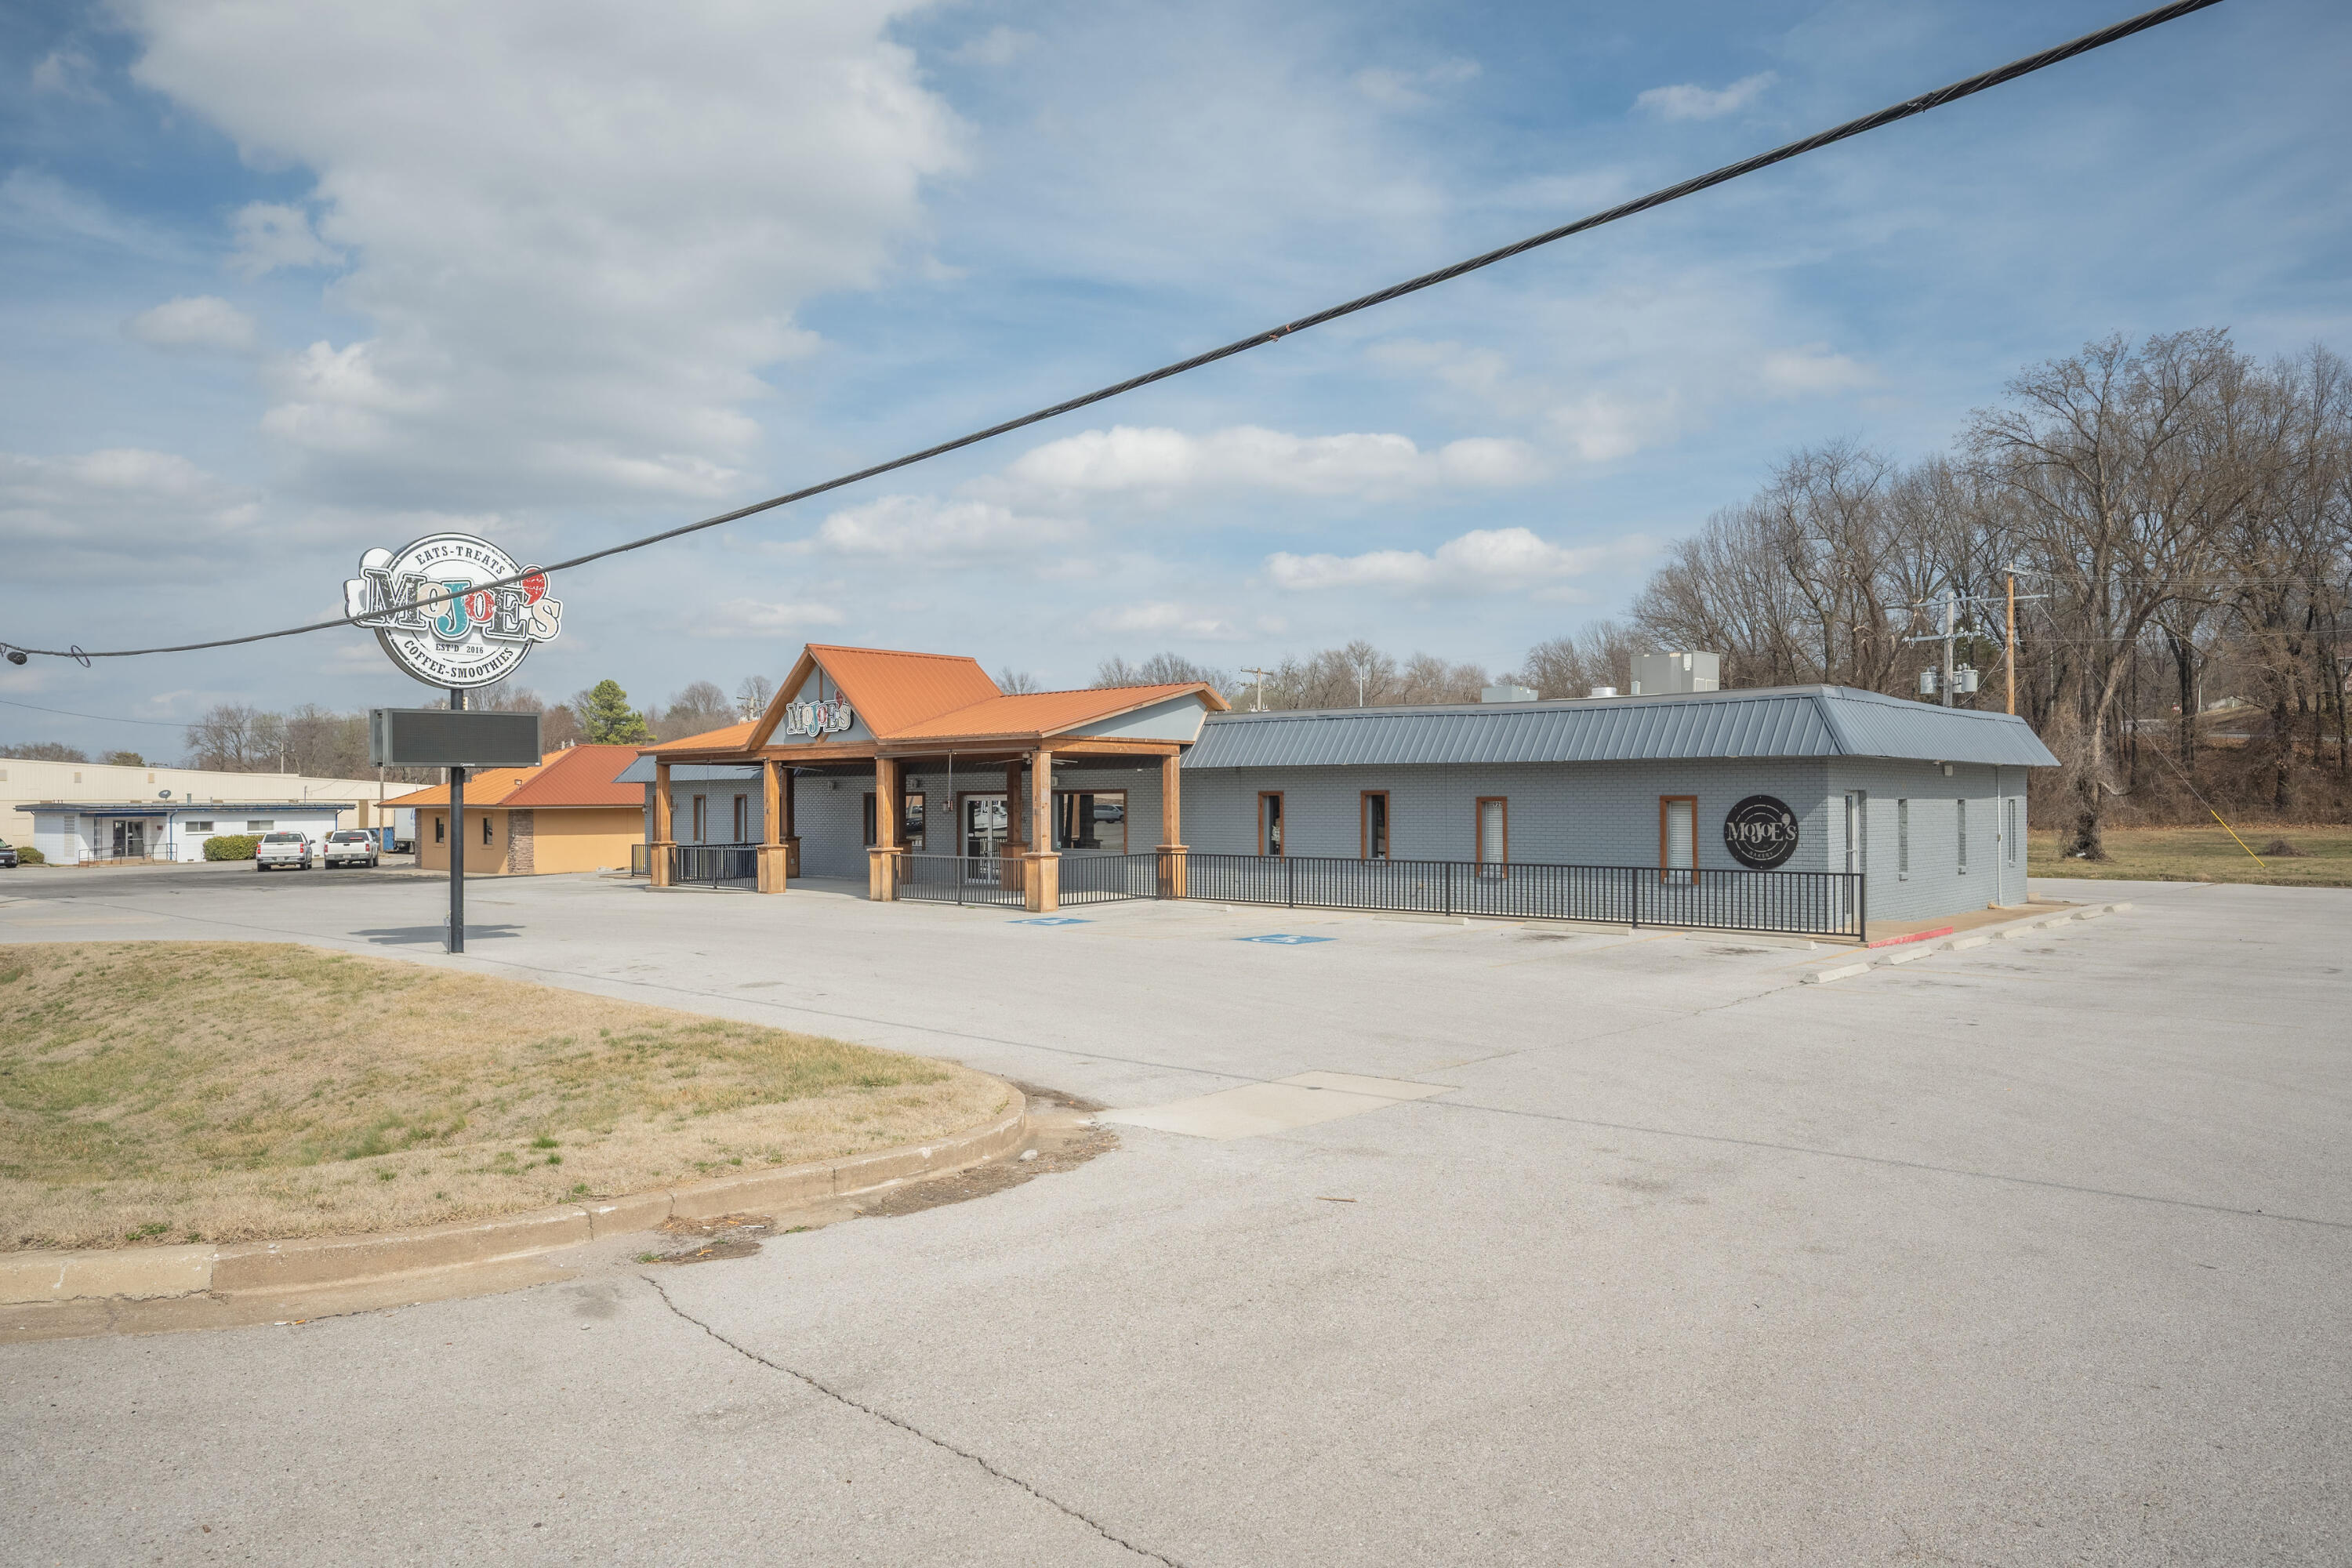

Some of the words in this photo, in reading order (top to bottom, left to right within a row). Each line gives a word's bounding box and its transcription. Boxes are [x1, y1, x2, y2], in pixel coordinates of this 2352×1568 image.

[415, 546, 506, 575] EATS-TREATS
[404, 640, 514, 679] COFFEE-SMOOTHIES
[435, 643, 459, 652] EST'D
[466, 644, 484, 654] 2016
